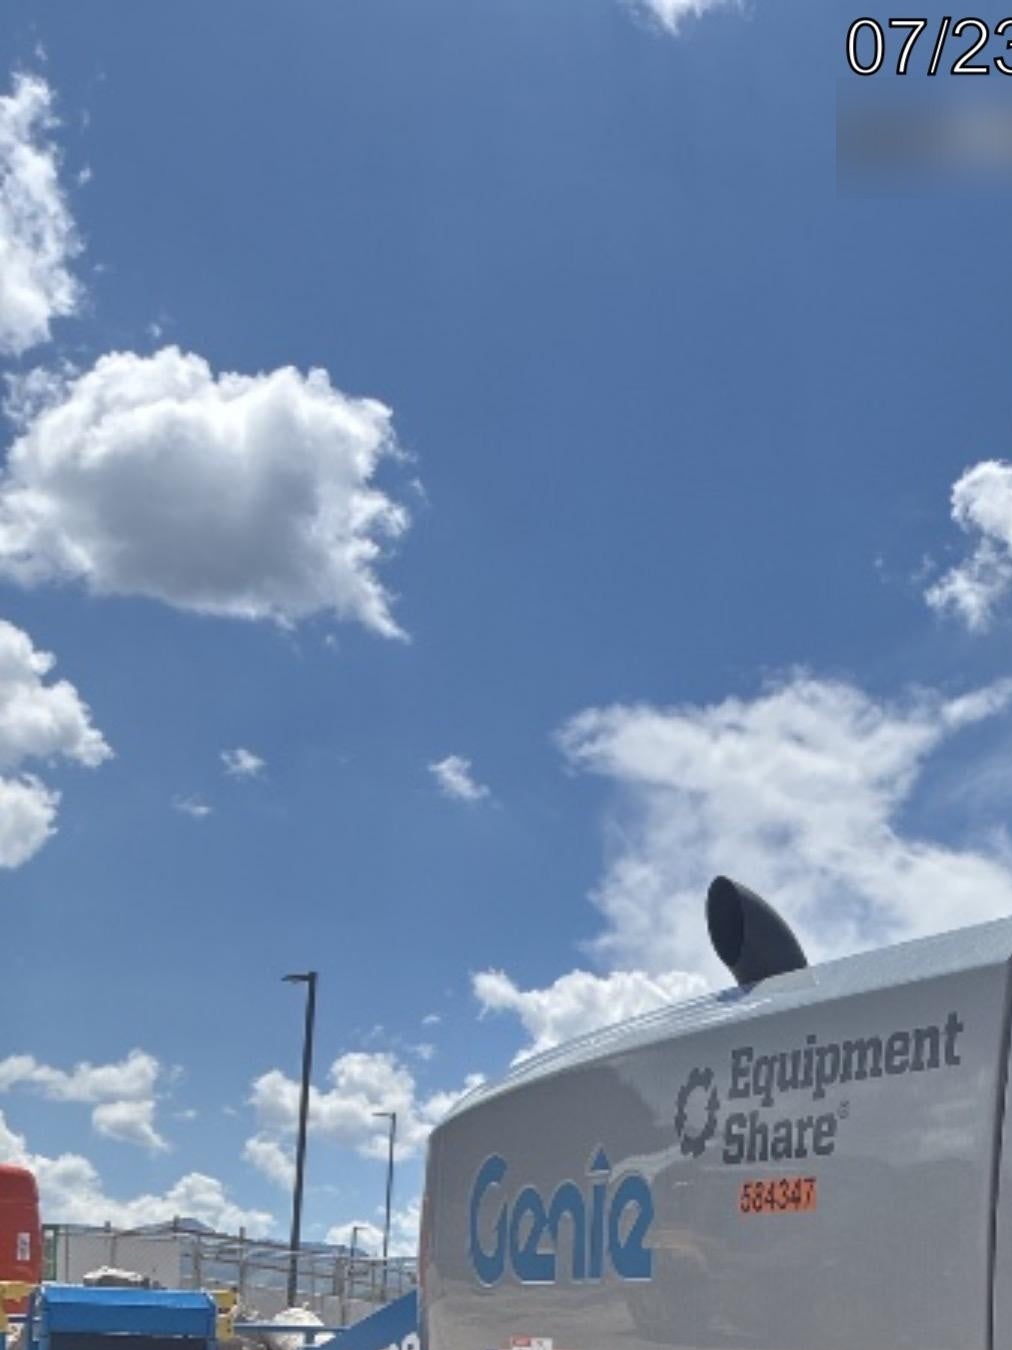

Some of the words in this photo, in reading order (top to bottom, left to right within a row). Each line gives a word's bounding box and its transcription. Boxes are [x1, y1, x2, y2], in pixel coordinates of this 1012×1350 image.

[728, 1012, 964, 1107] Equipment
[723, 1108, 836, 1164] Share
[469, 1143, 655, 1288] Genie
[740, 1178, 815, 1213] 584347
